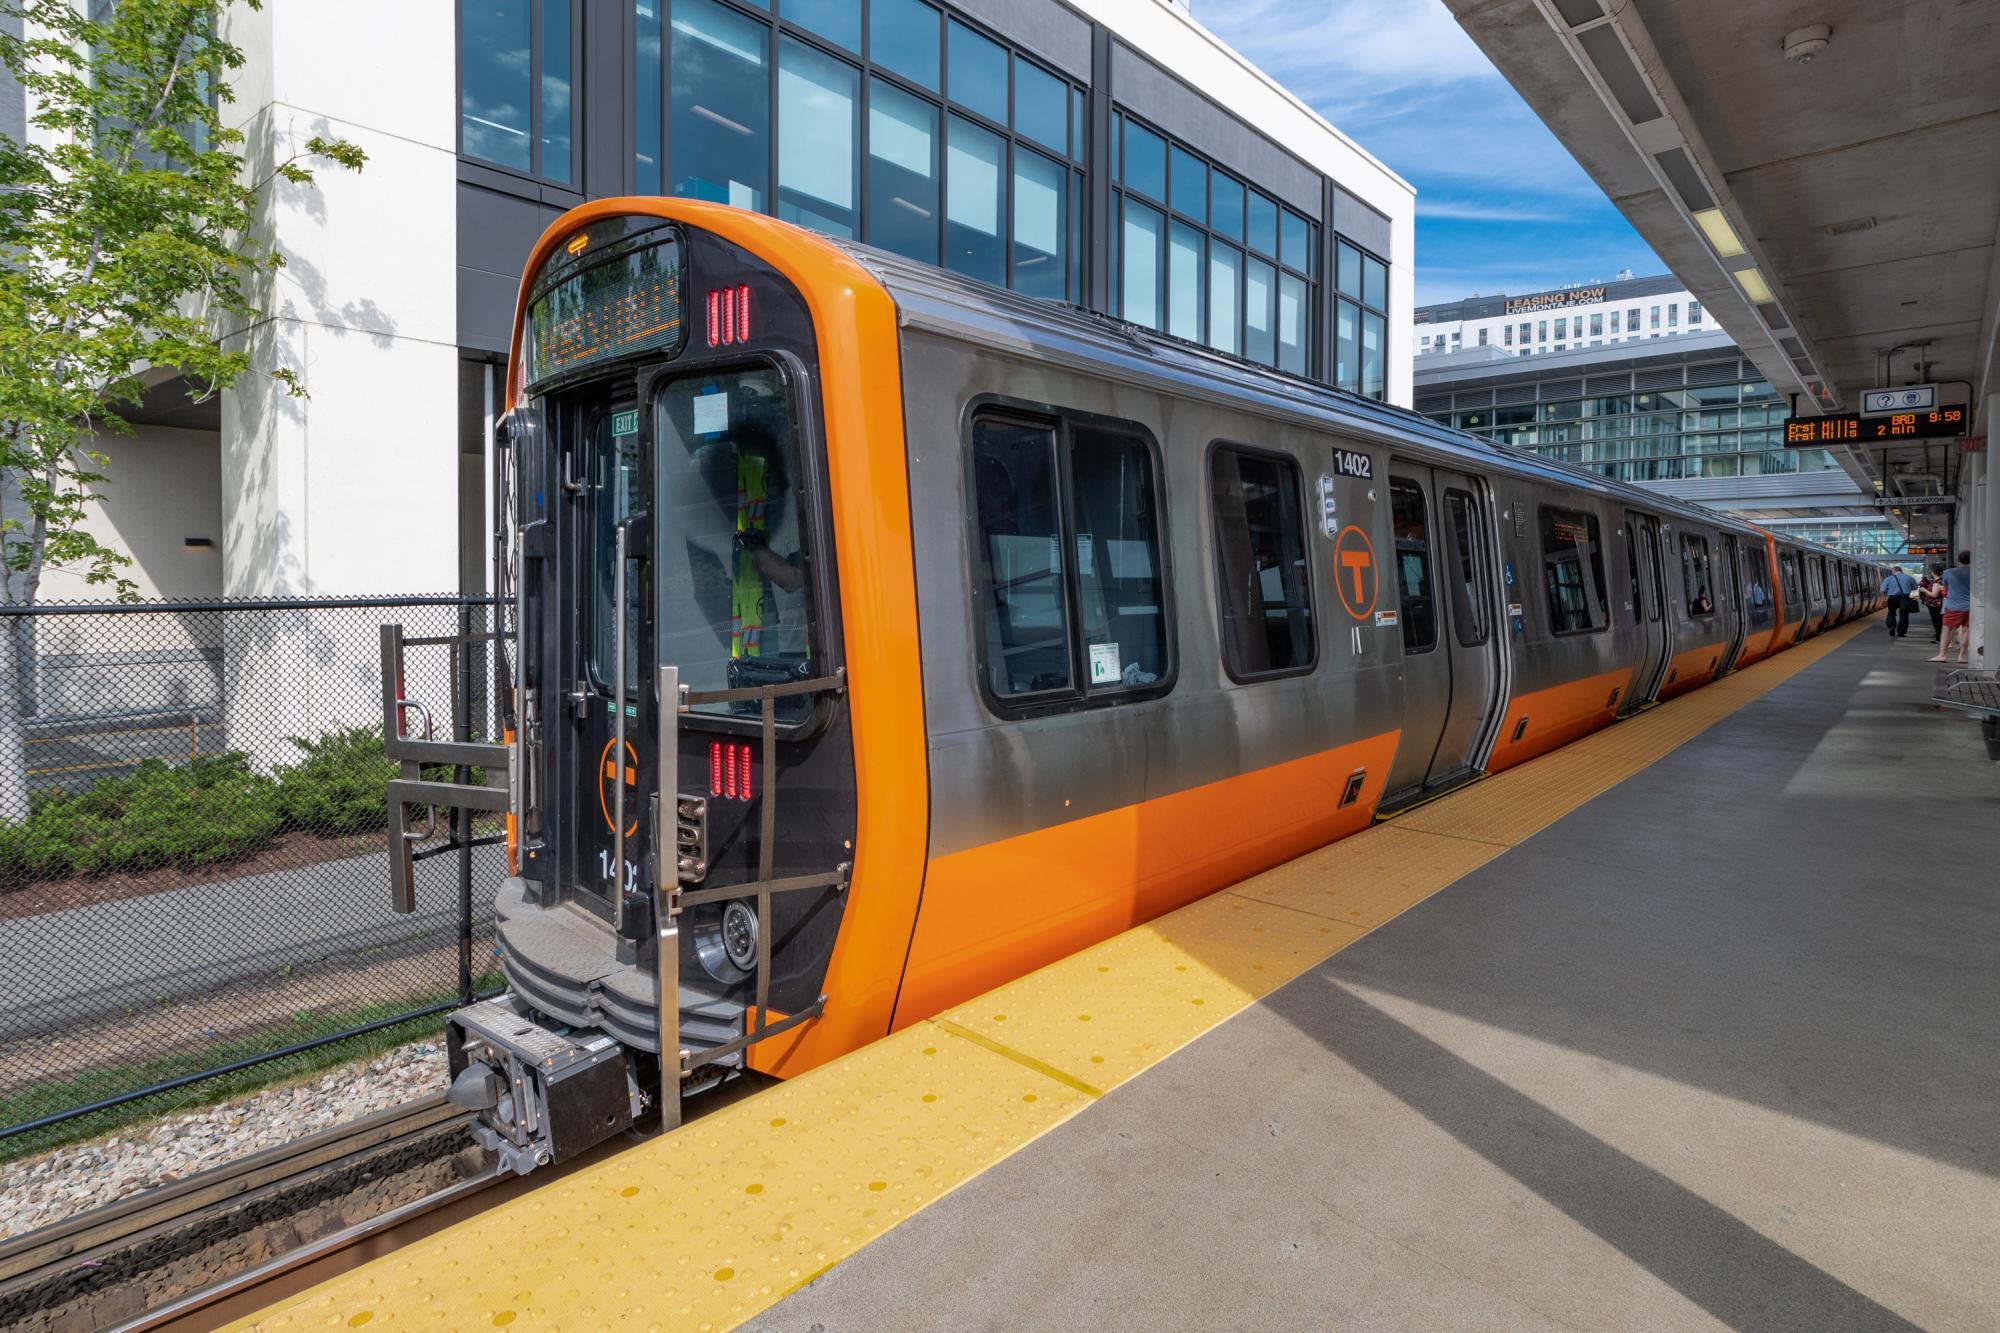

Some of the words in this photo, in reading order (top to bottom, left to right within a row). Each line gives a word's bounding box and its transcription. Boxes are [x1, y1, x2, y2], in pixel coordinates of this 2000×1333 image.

[1506, 294, 1565, 309] LEASING
[1569, 288, 1604, 300] NOW
[1506, 296, 1604, 315] LIVEMONTAJE.COM
[616, 414, 632, 433] EXIT
[1892, 414, 1915, 426] BRD
[1929, 411, 1961, 423] 9:58
[1877, 425, 1886, 436] 2
[1892, 424, 1915, 435] min
[1335, 450, 1371, 477] 1402
[1341, 551, 1370, 604] T
